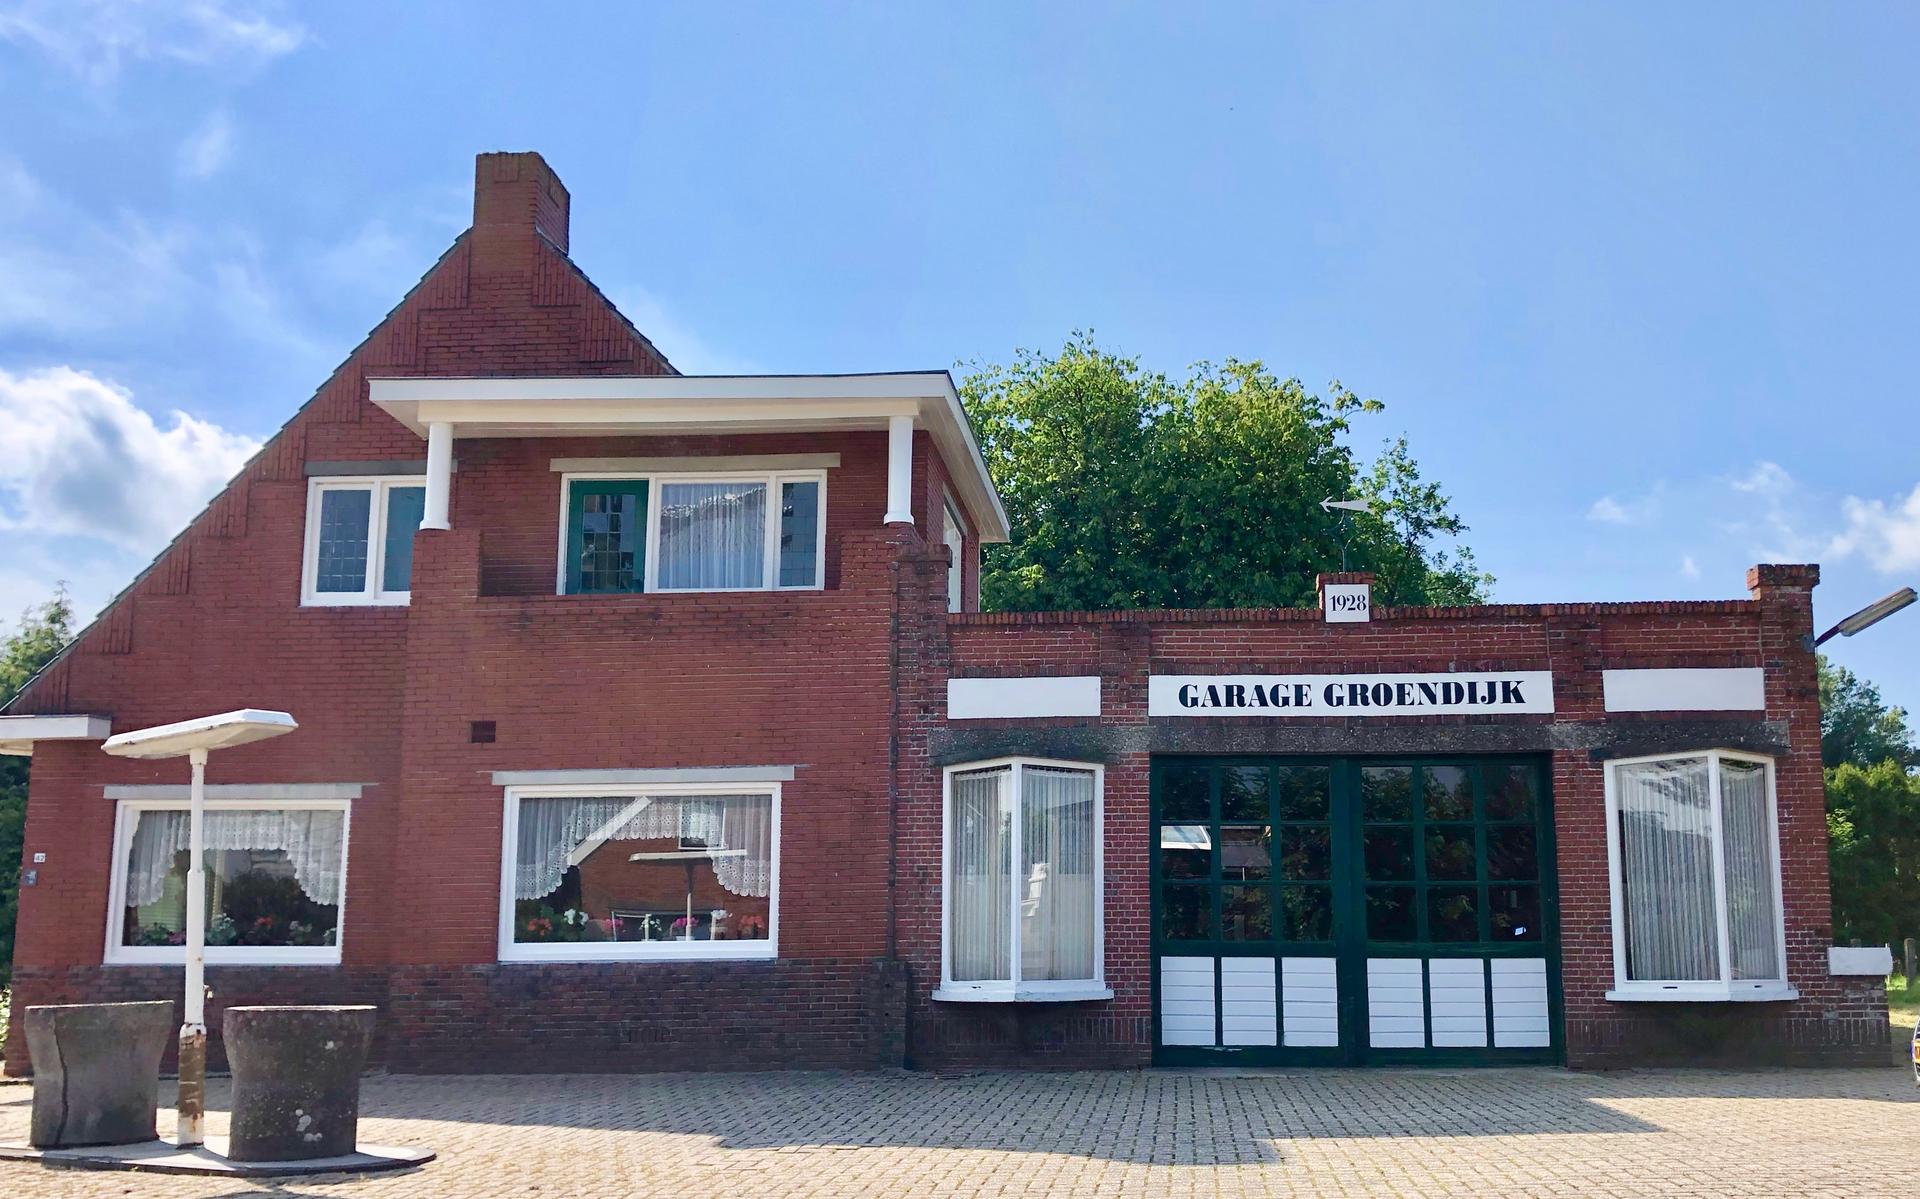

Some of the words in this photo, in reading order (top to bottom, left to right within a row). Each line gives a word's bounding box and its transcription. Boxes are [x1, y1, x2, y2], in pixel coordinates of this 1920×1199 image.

[1329, 594, 1367, 612] 1928
[1178, 683, 1312, 708] GARAGE
[1323, 680, 1527, 708] GROENDIJK
